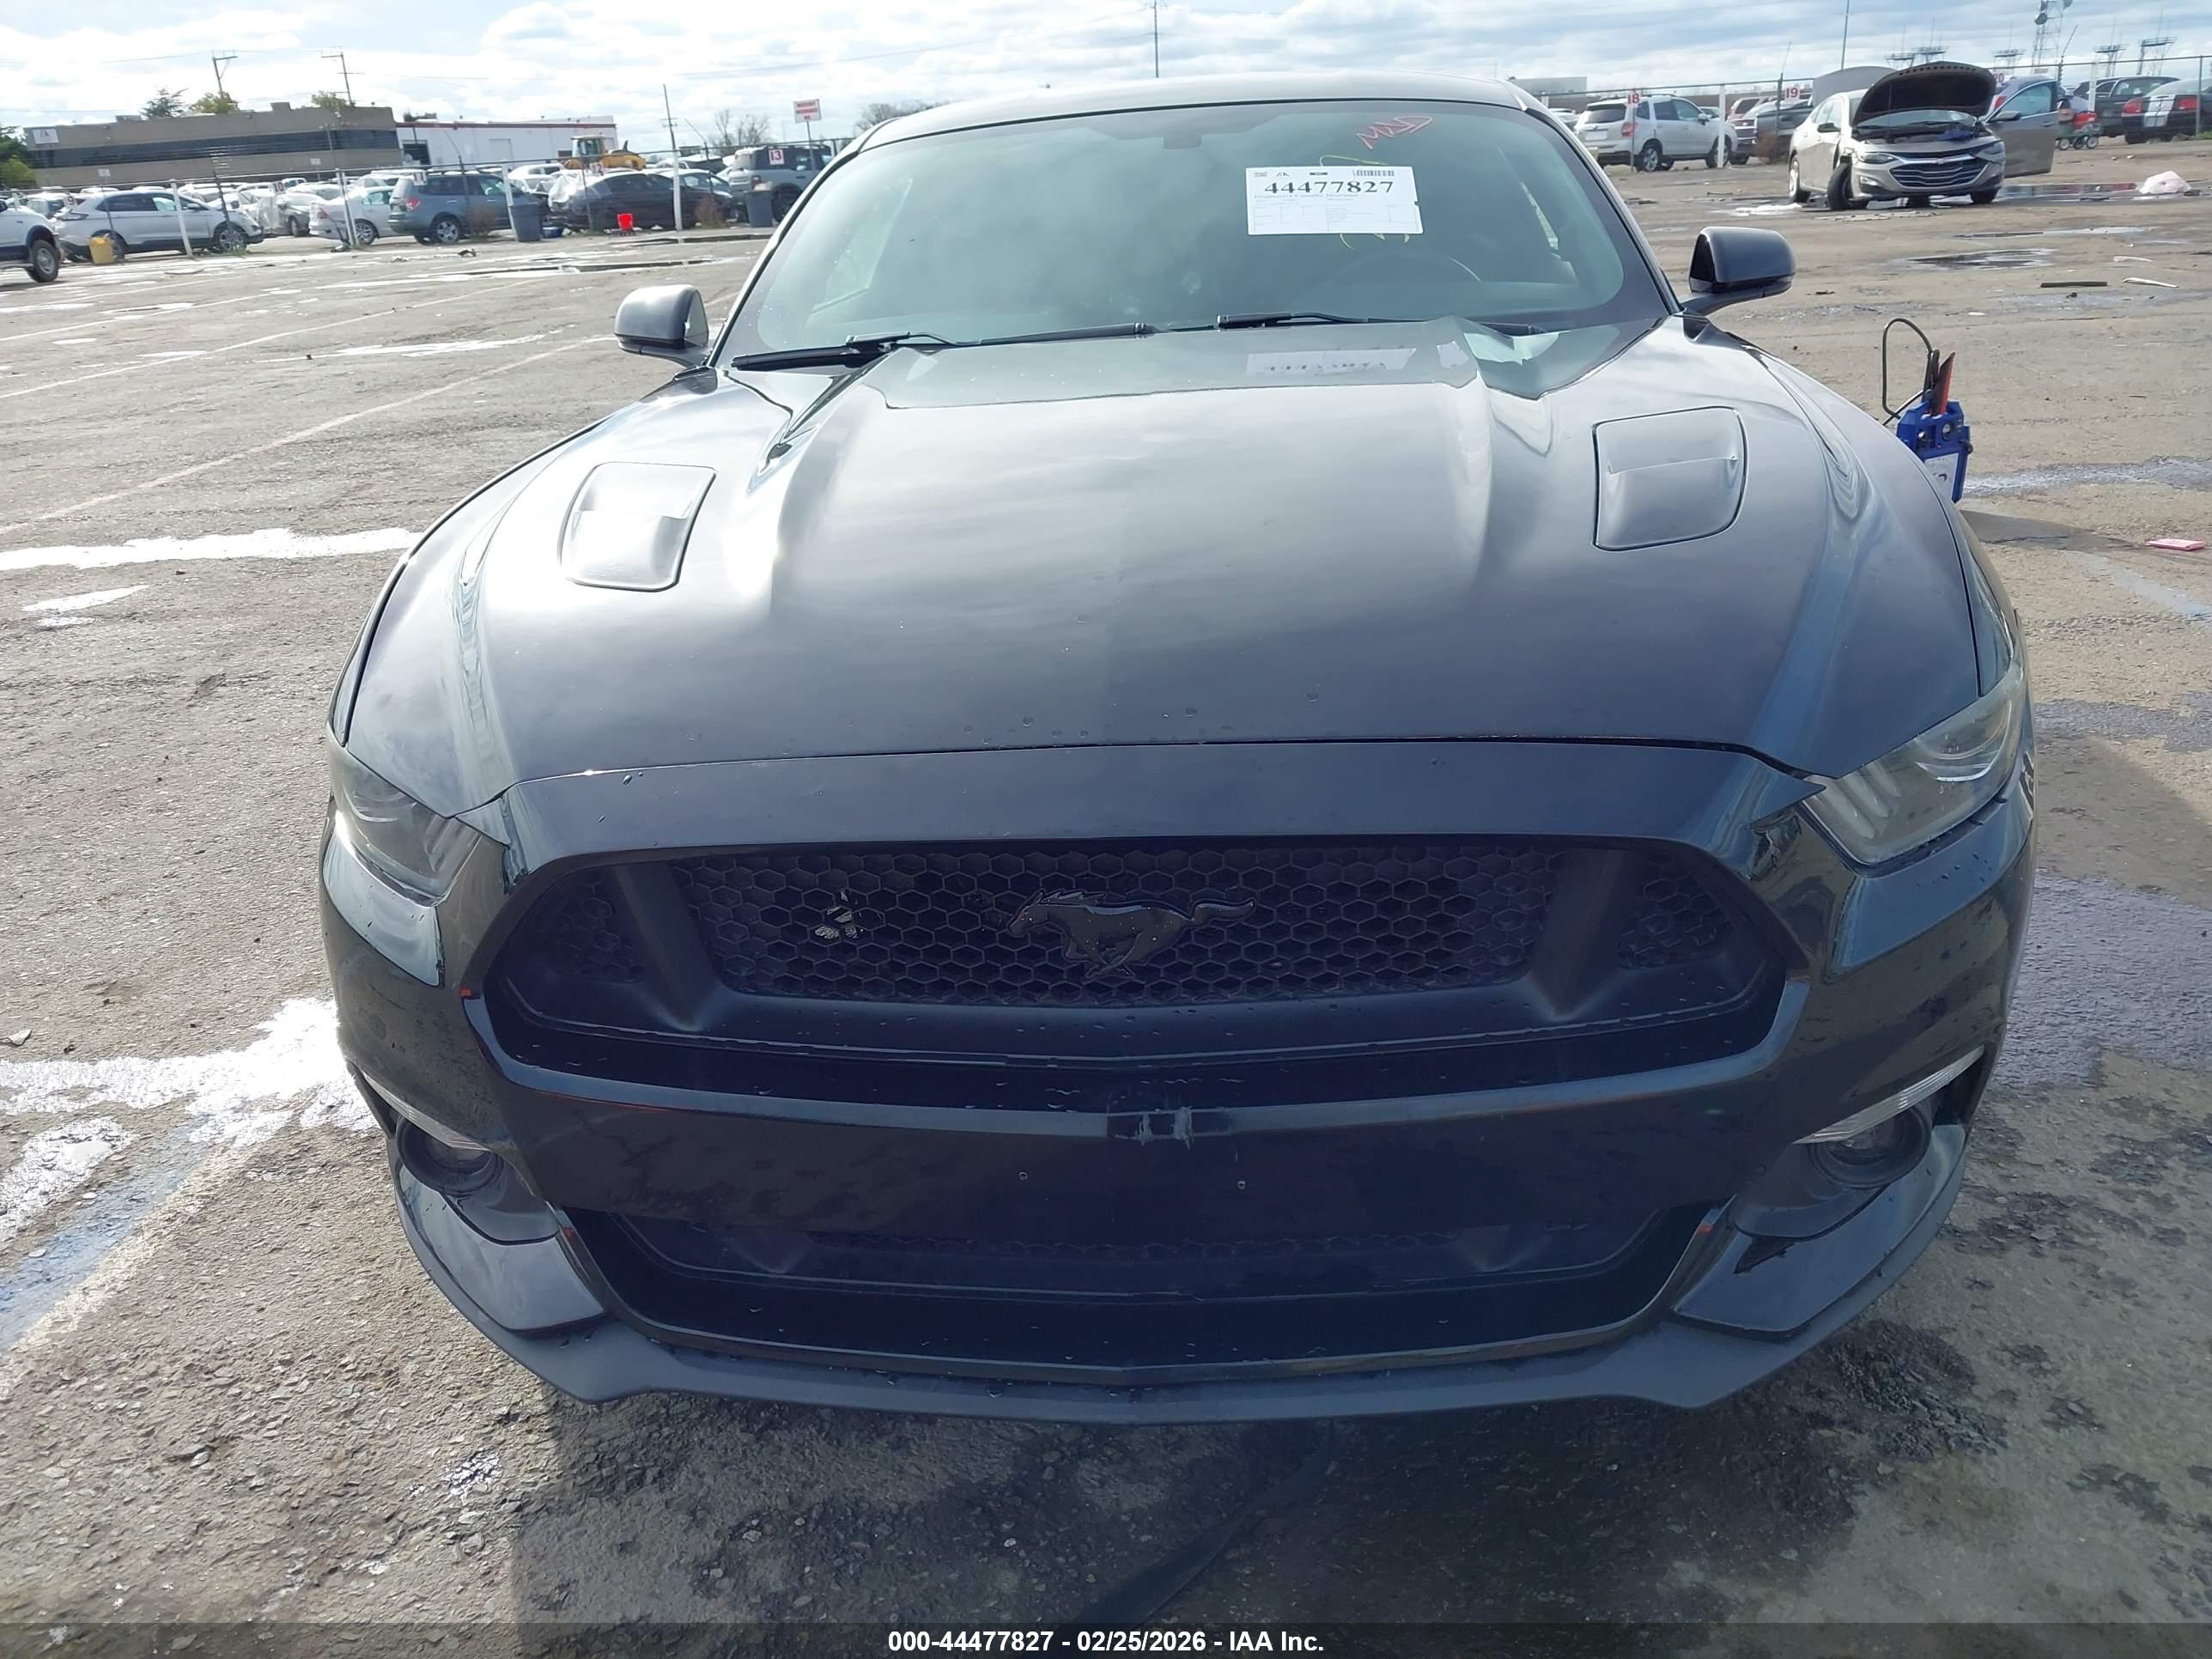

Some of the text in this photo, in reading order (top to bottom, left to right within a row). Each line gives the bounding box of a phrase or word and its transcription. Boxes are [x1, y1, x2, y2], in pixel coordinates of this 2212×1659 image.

[1786, 88, 1799, 99] 19
[1627, 94, 1640, 105] 18
[770, 150, 782, 161] 13
[274, 182, 284, 192] 10
[1264, 181, 1395, 194] 44477827
